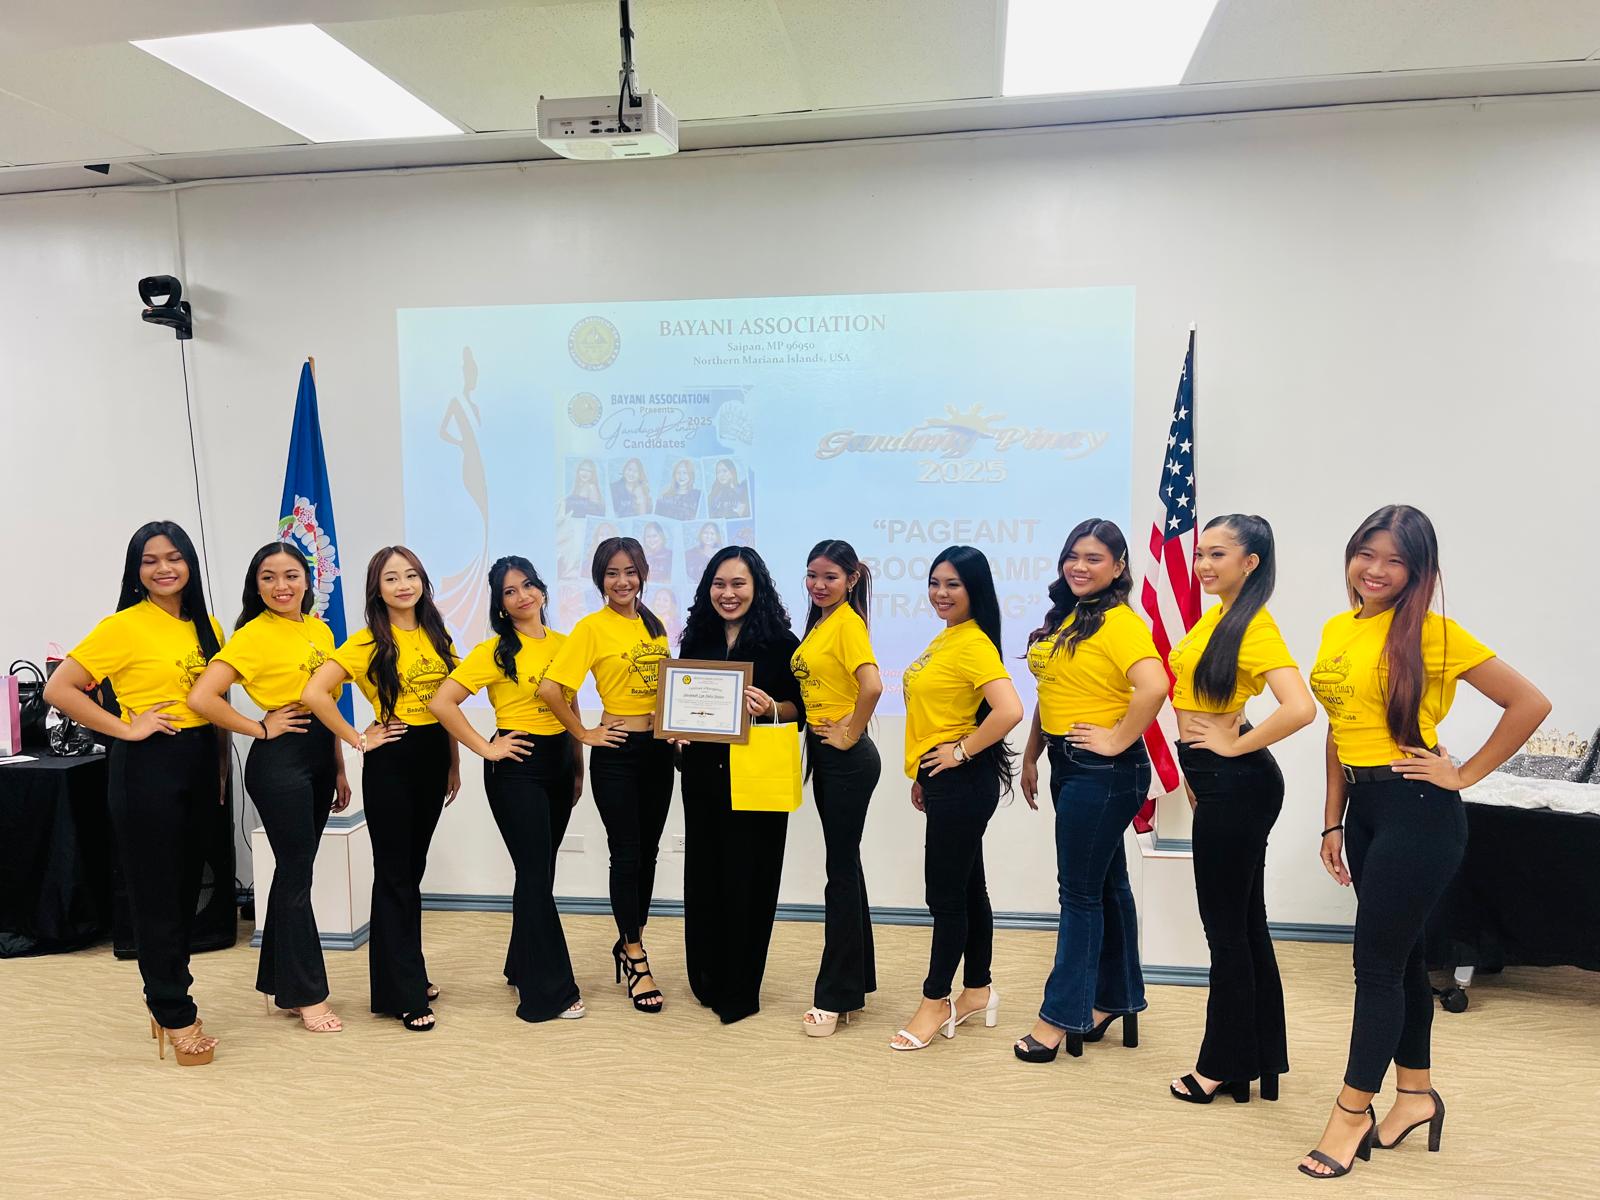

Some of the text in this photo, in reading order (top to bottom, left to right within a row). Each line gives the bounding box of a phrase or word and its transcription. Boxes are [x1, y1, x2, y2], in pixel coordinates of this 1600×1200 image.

[659, 314, 887, 336] BAYANI ASSOCIATION
[727, 341, 815, 353] Saipan, MP 96950
[693, 353, 851, 366] Northern Mariana Islands, USA
[611, 393, 710, 405] BAYANI ASSOCIATION
[687, 416, 712, 426] 2025
[623, 439, 685, 449] Candidates
[815, 427, 1109, 460] Gandang Pinay
[918, 460, 1007, 483] 2025
